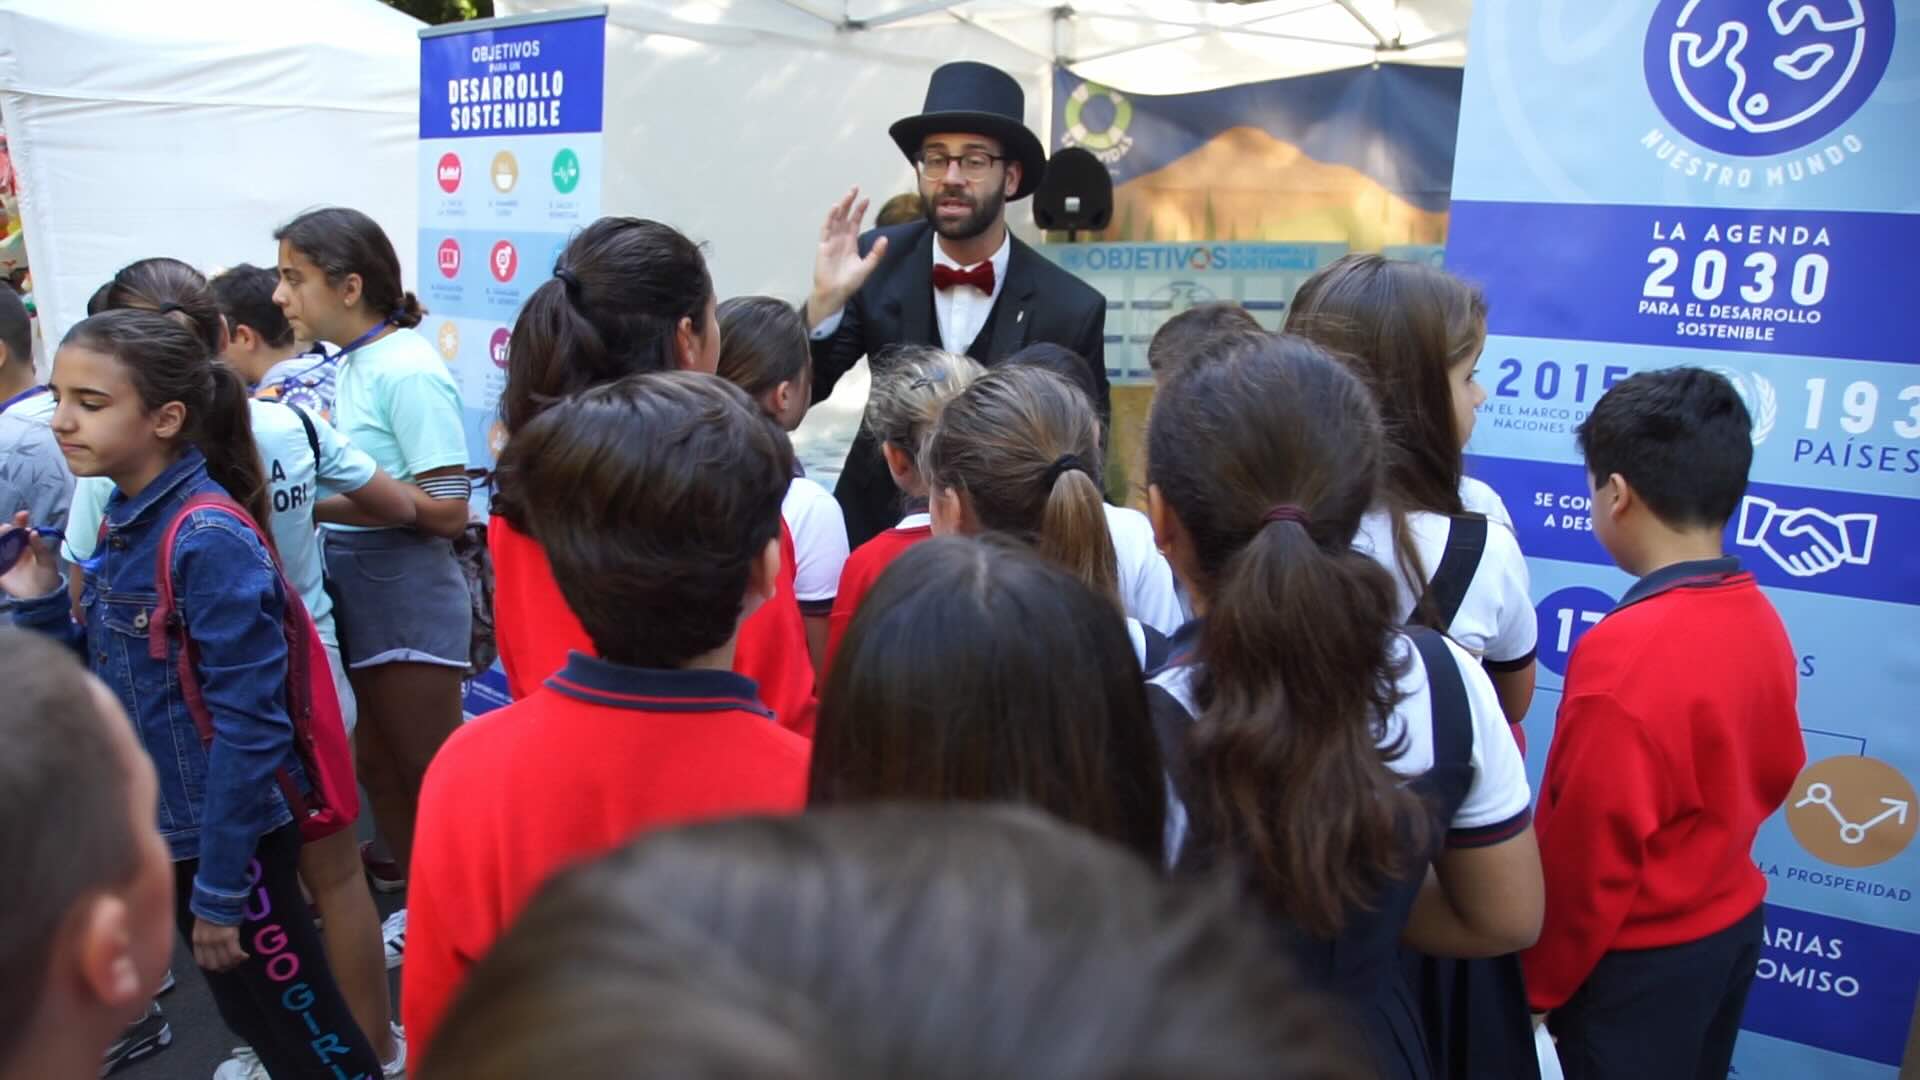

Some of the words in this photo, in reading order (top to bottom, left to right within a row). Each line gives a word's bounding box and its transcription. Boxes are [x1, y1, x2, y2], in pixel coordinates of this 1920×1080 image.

[472, 40, 540, 62] OBJETIVOS
[448, 70, 564, 104] DESARROLLO
[451, 100, 561, 131] SOSTENIBLE
[1640, 128, 1753, 189] NUESTRO
[1765, 132, 1863, 186] MUNDO
[1652, 220, 1687, 241] LA
[1704, 223, 1832, 247] AGENDA
[1086, 247, 1228, 271] OBJETIVOS
[1642, 246, 1830, 306] 2030
[1638, 300, 1680, 317] PARA
[1685, 304, 1705, 319] EL
[1710, 305, 1822, 325] DESARROLLO
[1676, 322, 1775, 342] SOSTENIBLE
[1498, 403, 1513, 416] EL
[1518, 406, 1570, 420] MARCO
[1804, 378, 1920, 440] 193
[1493, 418, 1564, 433] NACIONES
[1793, 436, 1920, 474] PAÍSES
[1534, 492, 1554, 507] SE
[1543, 513, 1556, 528] A
[1556, 608, 1606, 653] 17
[1786, 867, 1912, 902] PROSPERIDAD
[1755, 958, 1860, 997] OMISO
